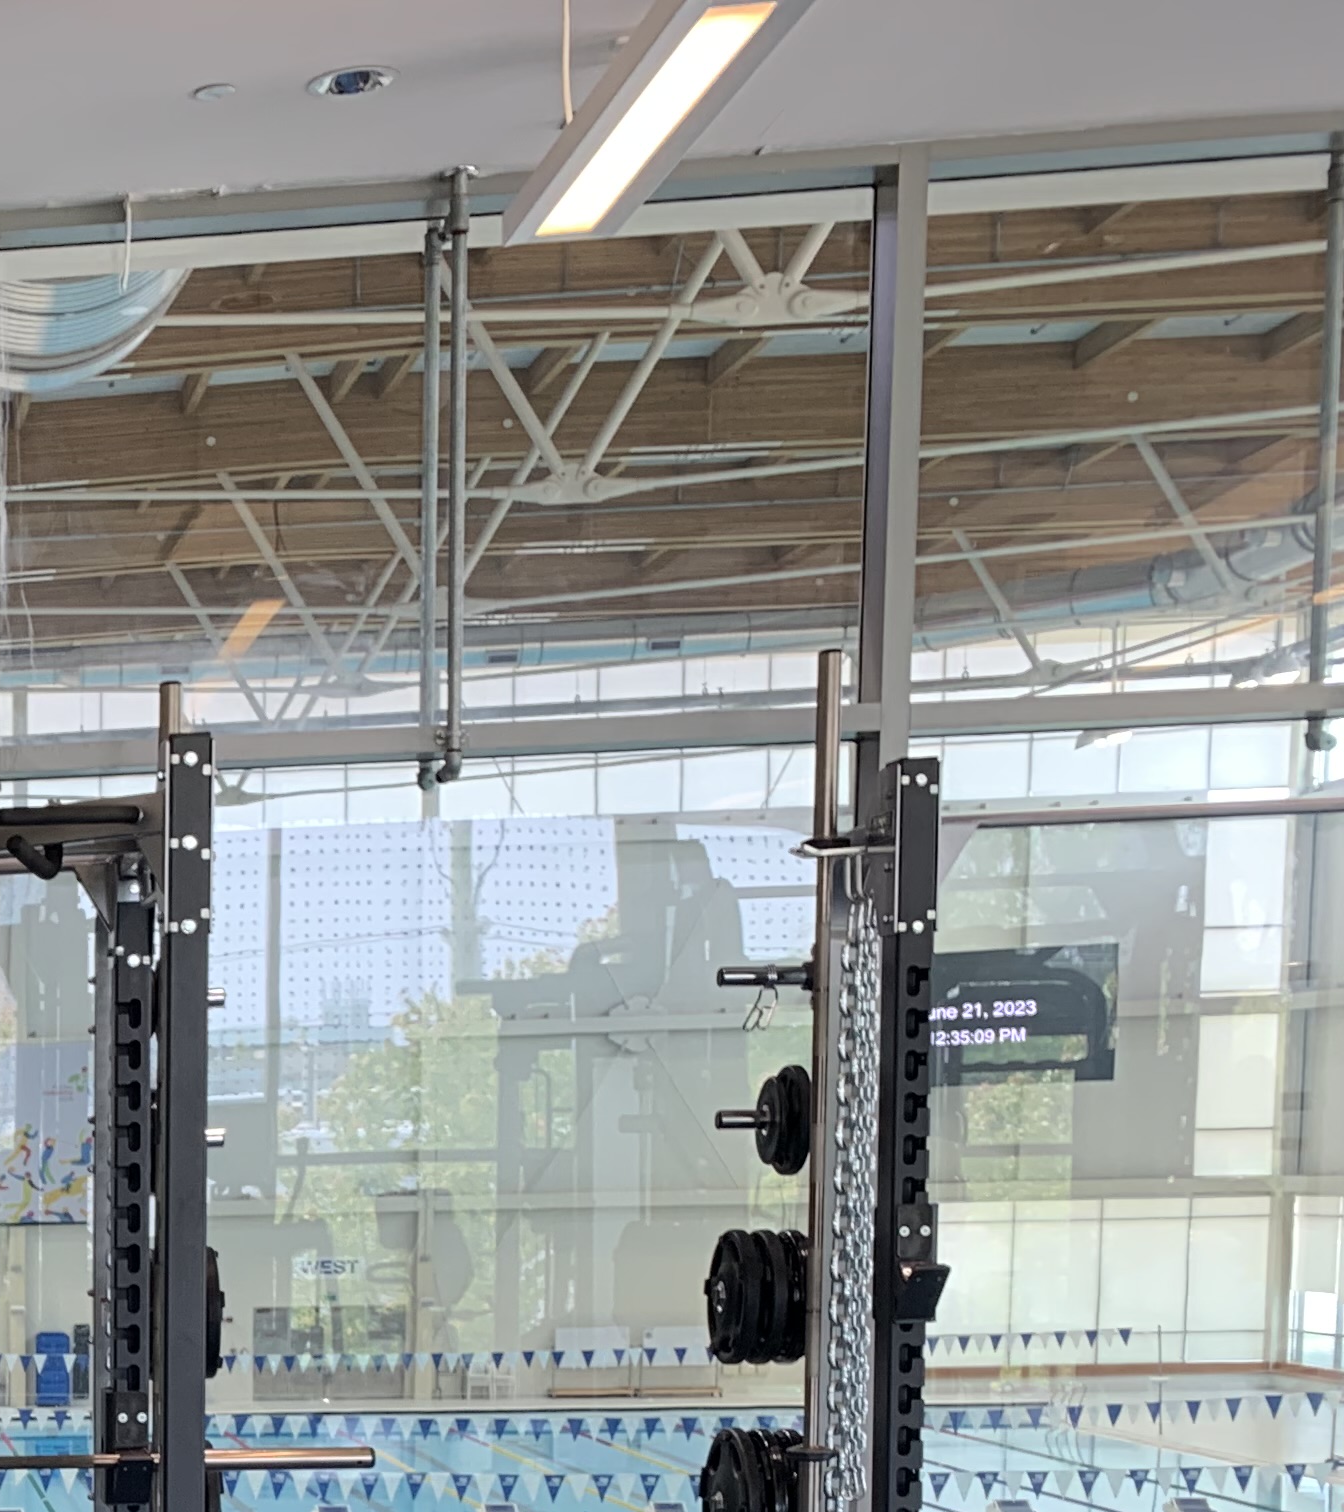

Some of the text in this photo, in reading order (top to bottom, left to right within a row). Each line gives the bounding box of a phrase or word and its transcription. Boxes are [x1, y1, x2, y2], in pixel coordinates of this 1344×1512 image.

[928, 999, 1038, 1021] une 21, 2023
[930, 1026, 1027, 1047] 12:35:09 PM
